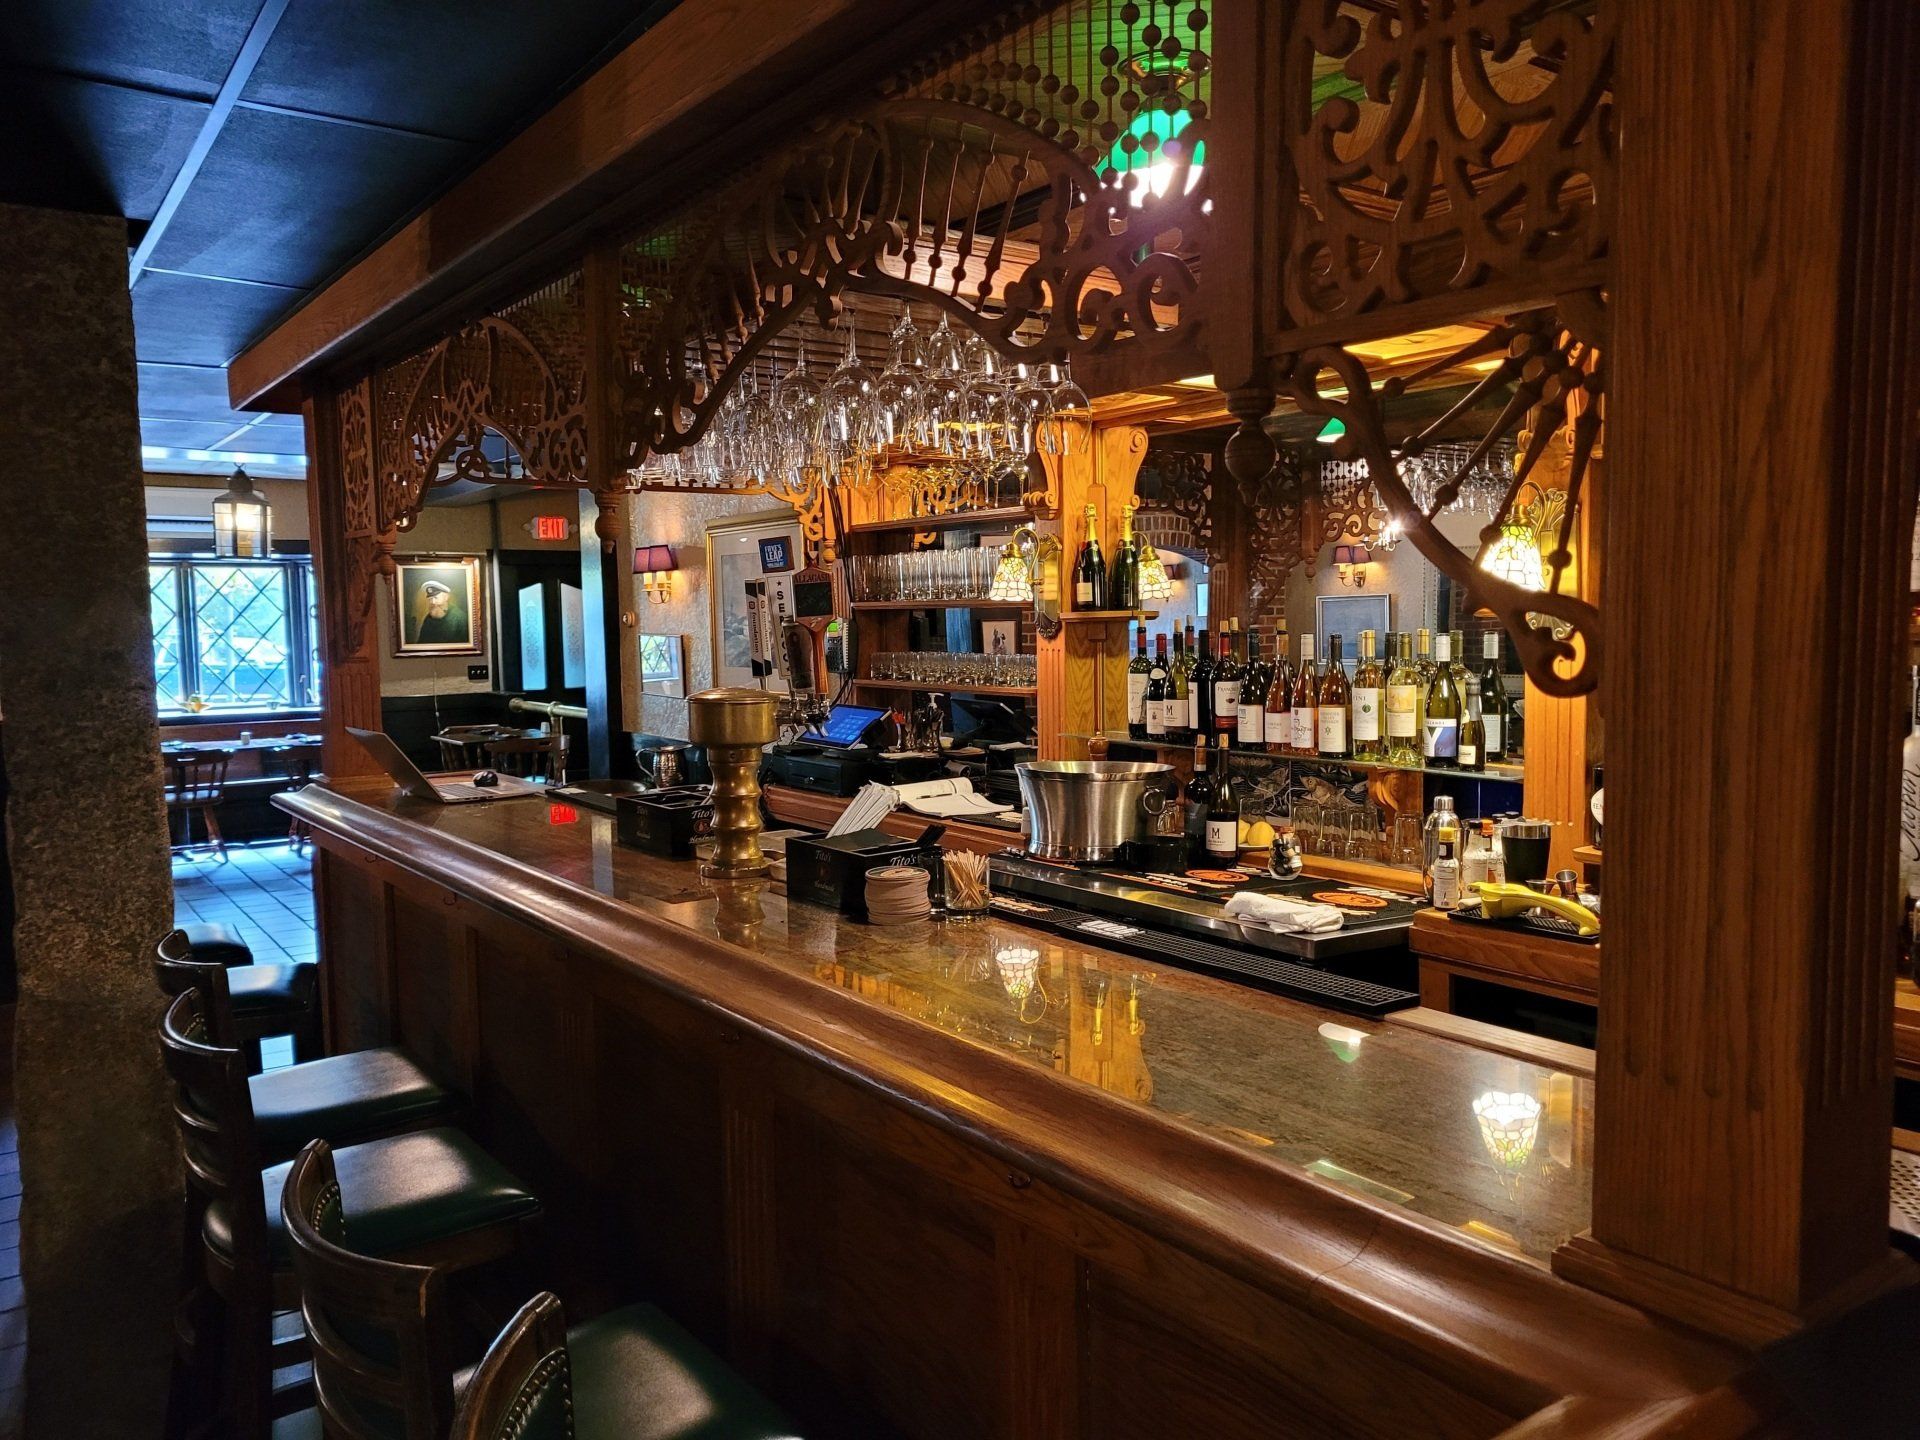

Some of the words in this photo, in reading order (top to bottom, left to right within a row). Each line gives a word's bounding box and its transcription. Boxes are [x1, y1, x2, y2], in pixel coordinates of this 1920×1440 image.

[539, 518, 564, 539] EXIT
[765, 550, 783, 561] LEAP
[751, 611, 760, 654] foundation
[1211, 827, 1220, 840] M
[815, 849, 832, 862] Tito's
[889, 854, 917, 867] Tito's
